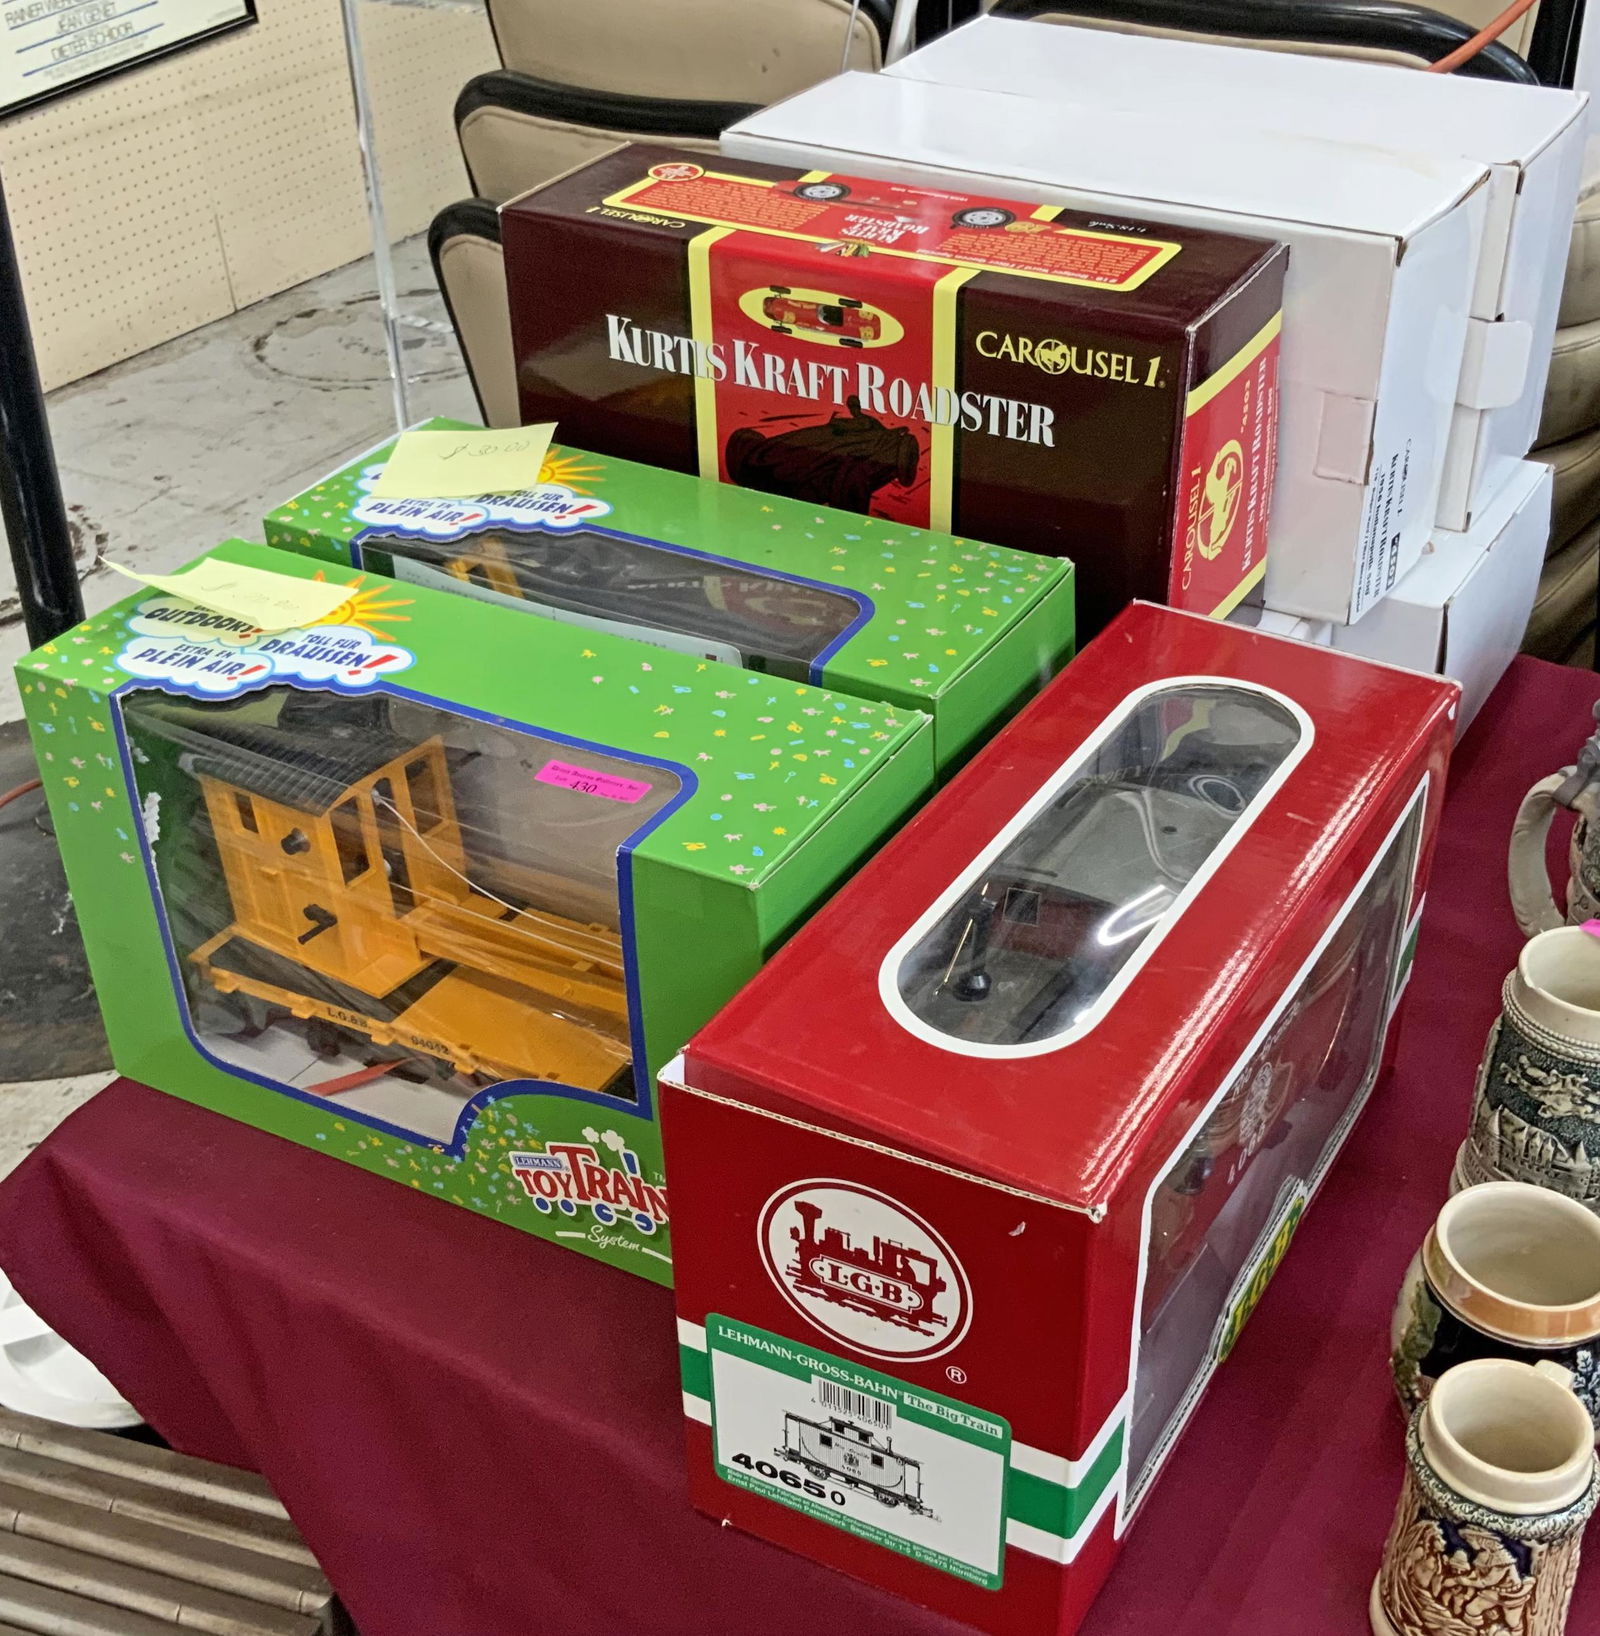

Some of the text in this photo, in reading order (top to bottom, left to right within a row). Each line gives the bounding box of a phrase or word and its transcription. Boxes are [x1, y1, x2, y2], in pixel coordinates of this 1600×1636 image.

[606, 314, 1056, 447] KURTIS KRAFT ROADSTER
[365, 502, 428, 517] PLEIN
[1182, 483, 1201, 591] CAROUSEL
[301, 634, 333, 646] TOLL
[132, 648, 205, 668] PLEIN
[173, 644, 236, 659] EXTRA EN
[570, 780, 597, 794] 430
[514, 1155, 562, 1169] LEHMANN
[587, 1224, 641, 1250] System
[718, 1325, 999, 1437] LEHMANN-GROSS-BAHN The Big Train
[727, 1473, 748, 1488] Ernst
[749, 1482, 766, 1495] Paul
[767, 1489, 801, 1509] Lehmann
